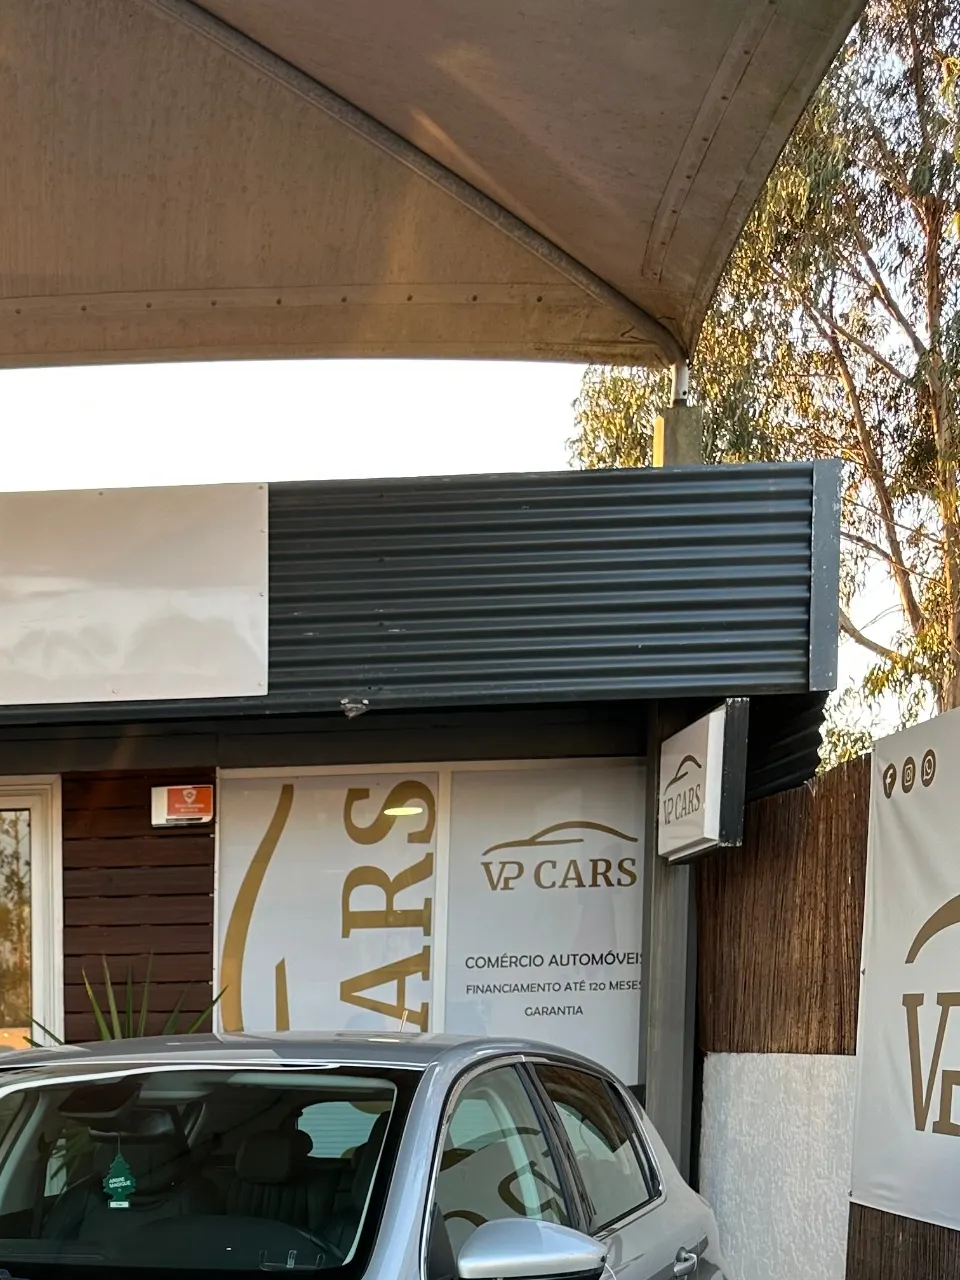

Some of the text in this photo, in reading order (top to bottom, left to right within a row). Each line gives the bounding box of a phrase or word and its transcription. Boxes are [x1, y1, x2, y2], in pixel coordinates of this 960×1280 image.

[663, 783, 701, 825] VP CARS
[481, 857, 638, 891] VP CARS
[465, 953, 544, 969] COMÉRCIO
[466, 981, 562, 995] FINANCIAMENTO
[564, 979, 586, 992] ATÉ
[589, 982, 606, 992] 120
[524, 1005, 584, 1017] GARANTIA
